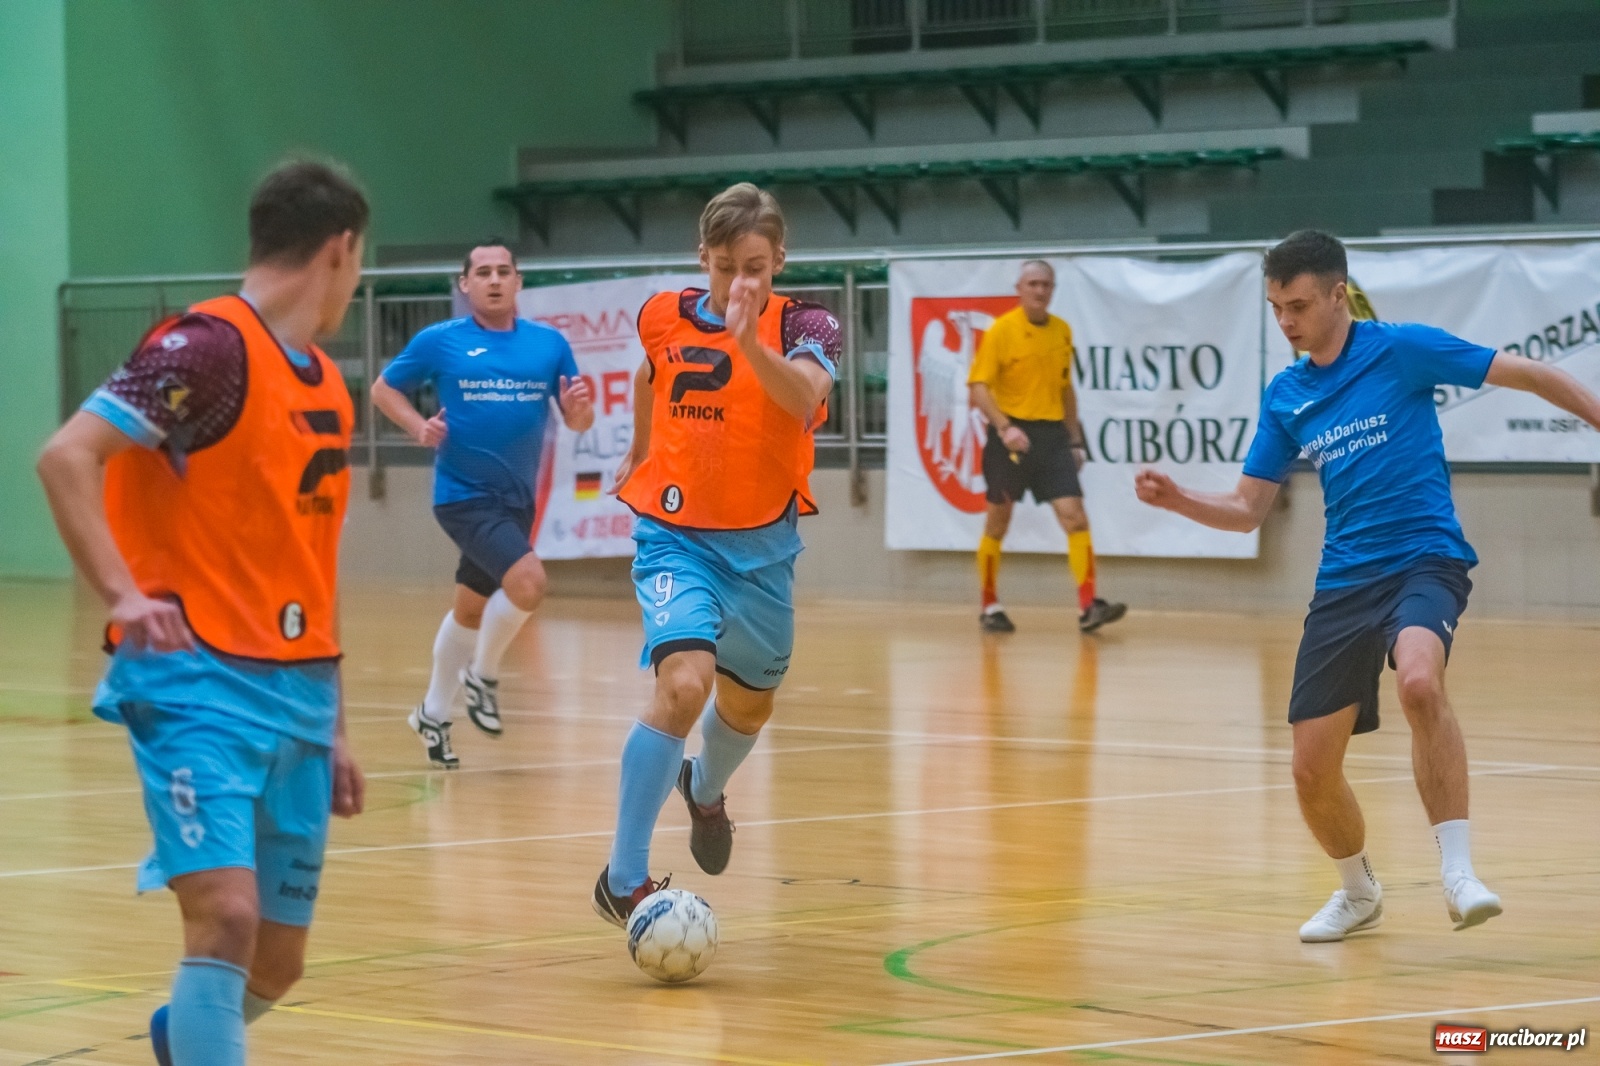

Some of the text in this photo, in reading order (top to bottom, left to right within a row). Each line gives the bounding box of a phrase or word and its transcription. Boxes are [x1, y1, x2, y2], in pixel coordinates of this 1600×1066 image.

[669, 405, 725, 422] ATRICK
[1348, 431, 1388, 453] GmbH
[665, 487, 680, 512] 9
[654, 571, 674, 608] 9
[284, 603, 302, 639] 6
